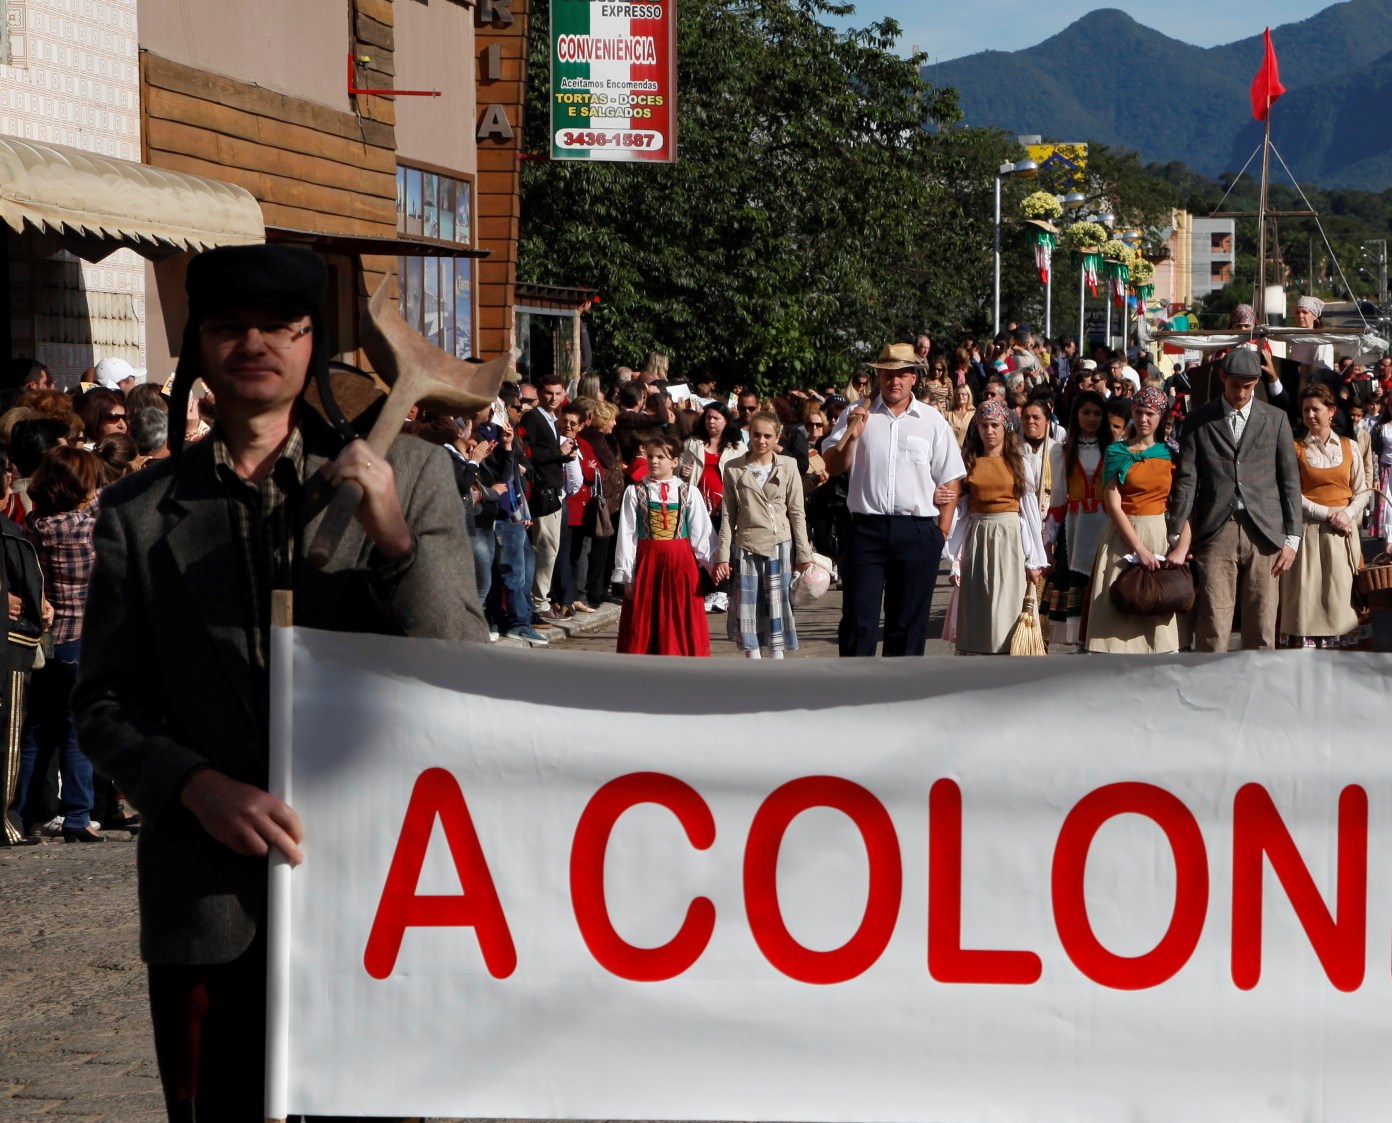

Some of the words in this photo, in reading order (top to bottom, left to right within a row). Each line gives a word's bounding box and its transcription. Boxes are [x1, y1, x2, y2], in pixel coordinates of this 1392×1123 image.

[601, 5, 661, 18] EXPRESSO
[558, 34, 656, 62] CONVENIÊNCIA
[561, 78, 604, 89] Aceitamos
[606, 79, 657, 90] Encomendas
[556, 93, 608, 104] TORTAS
[619, 94, 664, 106] DOCES
[568, 107, 577, 117] E
[580, 107, 652, 118] SALGADOS
[563, 132, 655, 147] 3436-1587
[364, 767, 518, 980] A
